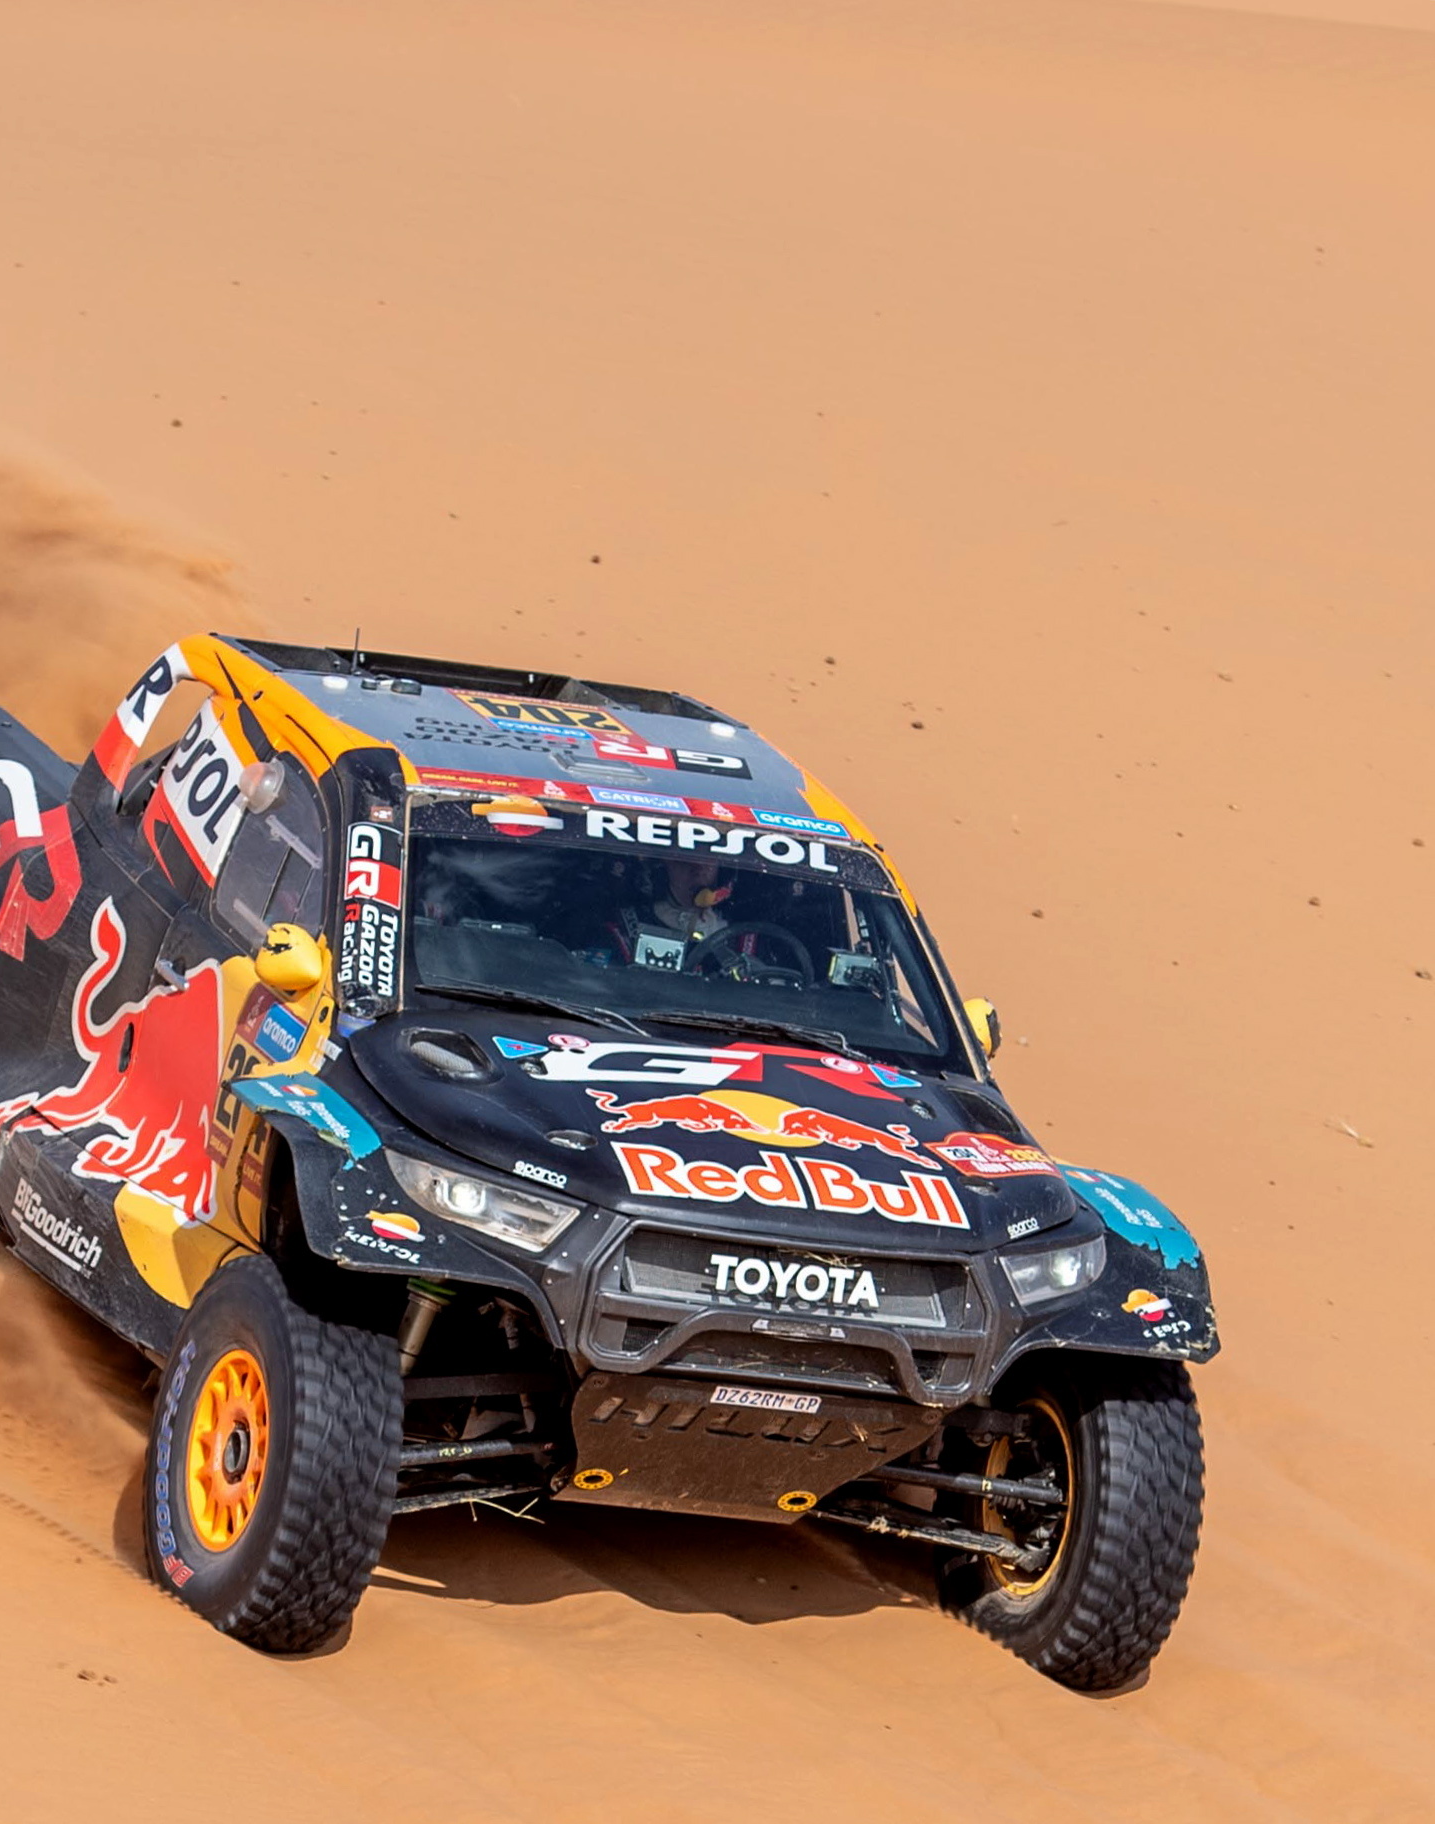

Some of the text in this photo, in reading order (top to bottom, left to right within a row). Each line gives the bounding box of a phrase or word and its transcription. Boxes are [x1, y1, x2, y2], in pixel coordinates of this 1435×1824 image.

[468, 697, 621, 732] 204
[585, 809, 839, 873] REPSOL
[759, 812, 841, 834] aramco
[347, 825, 382, 898] GR
[337, 902, 361, 983] Racing
[358, 904, 379, 987] GAZOO
[378, 911, 398, 997] TOYOTA
[263, 1017, 297, 1054] aramco
[528, 1042, 906, 1102] GR
[611, 1141, 971, 1230] Red Bull
[13, 1177, 103, 1268] BFGoodrich
[710, 1254, 880, 1308] TOYOTA
[794, 1397, 820, 1411] GP
